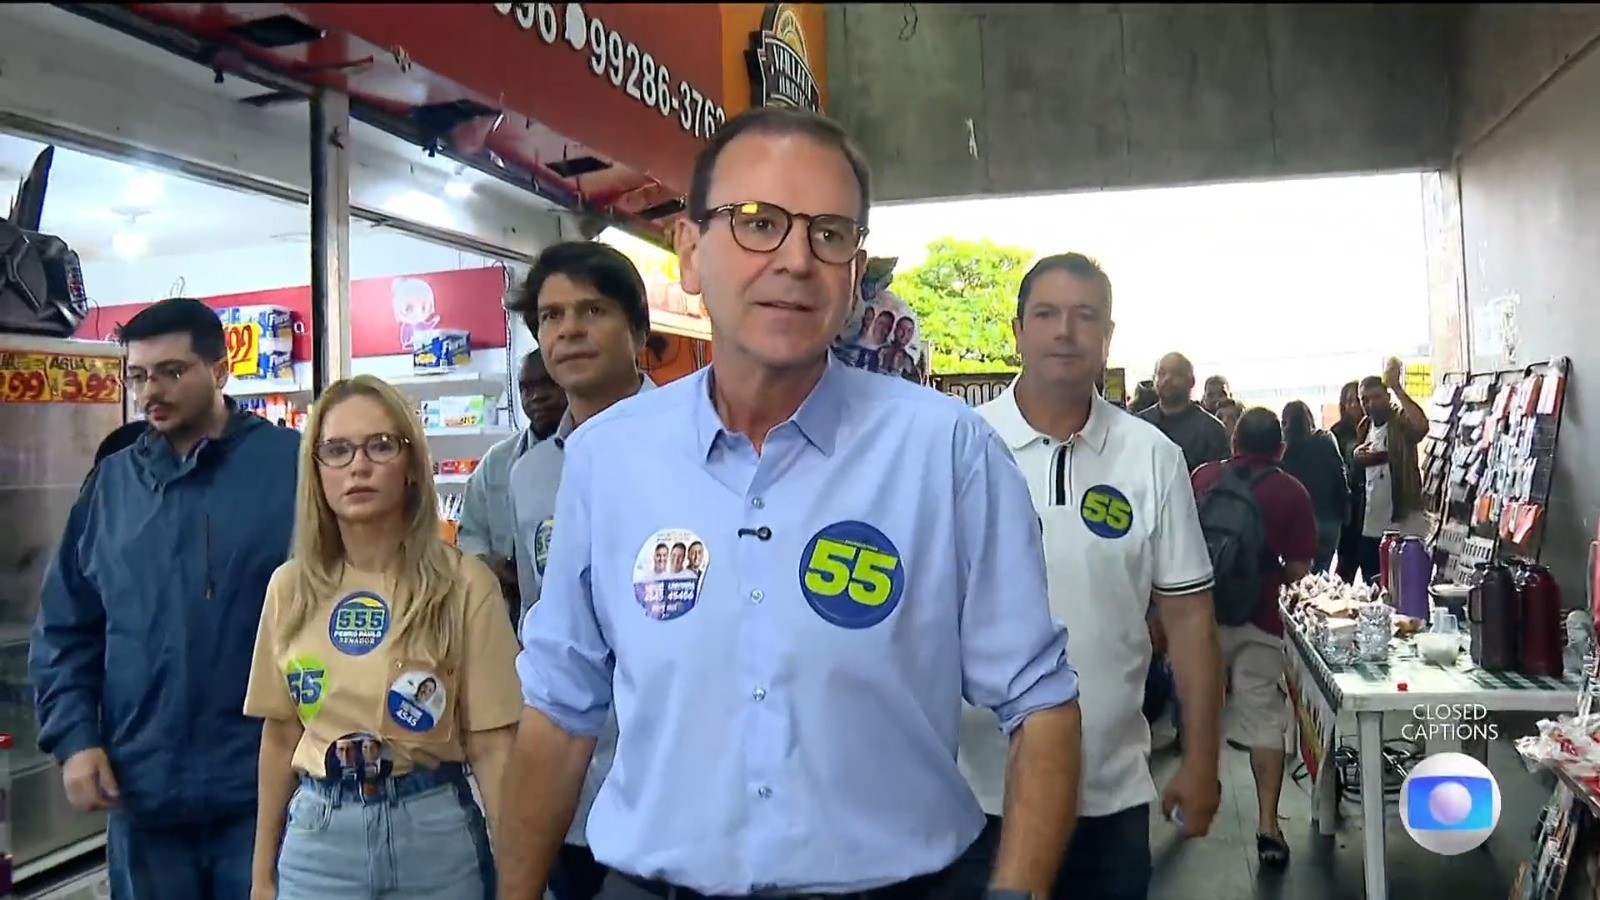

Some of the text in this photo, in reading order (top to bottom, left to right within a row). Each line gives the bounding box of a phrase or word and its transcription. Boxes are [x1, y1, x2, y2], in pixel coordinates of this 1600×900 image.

[1082, 491, 1131, 530] 55
[804, 538, 898, 606] 55
[338, 611, 384, 629] 555
[287, 669, 325, 706] 55
